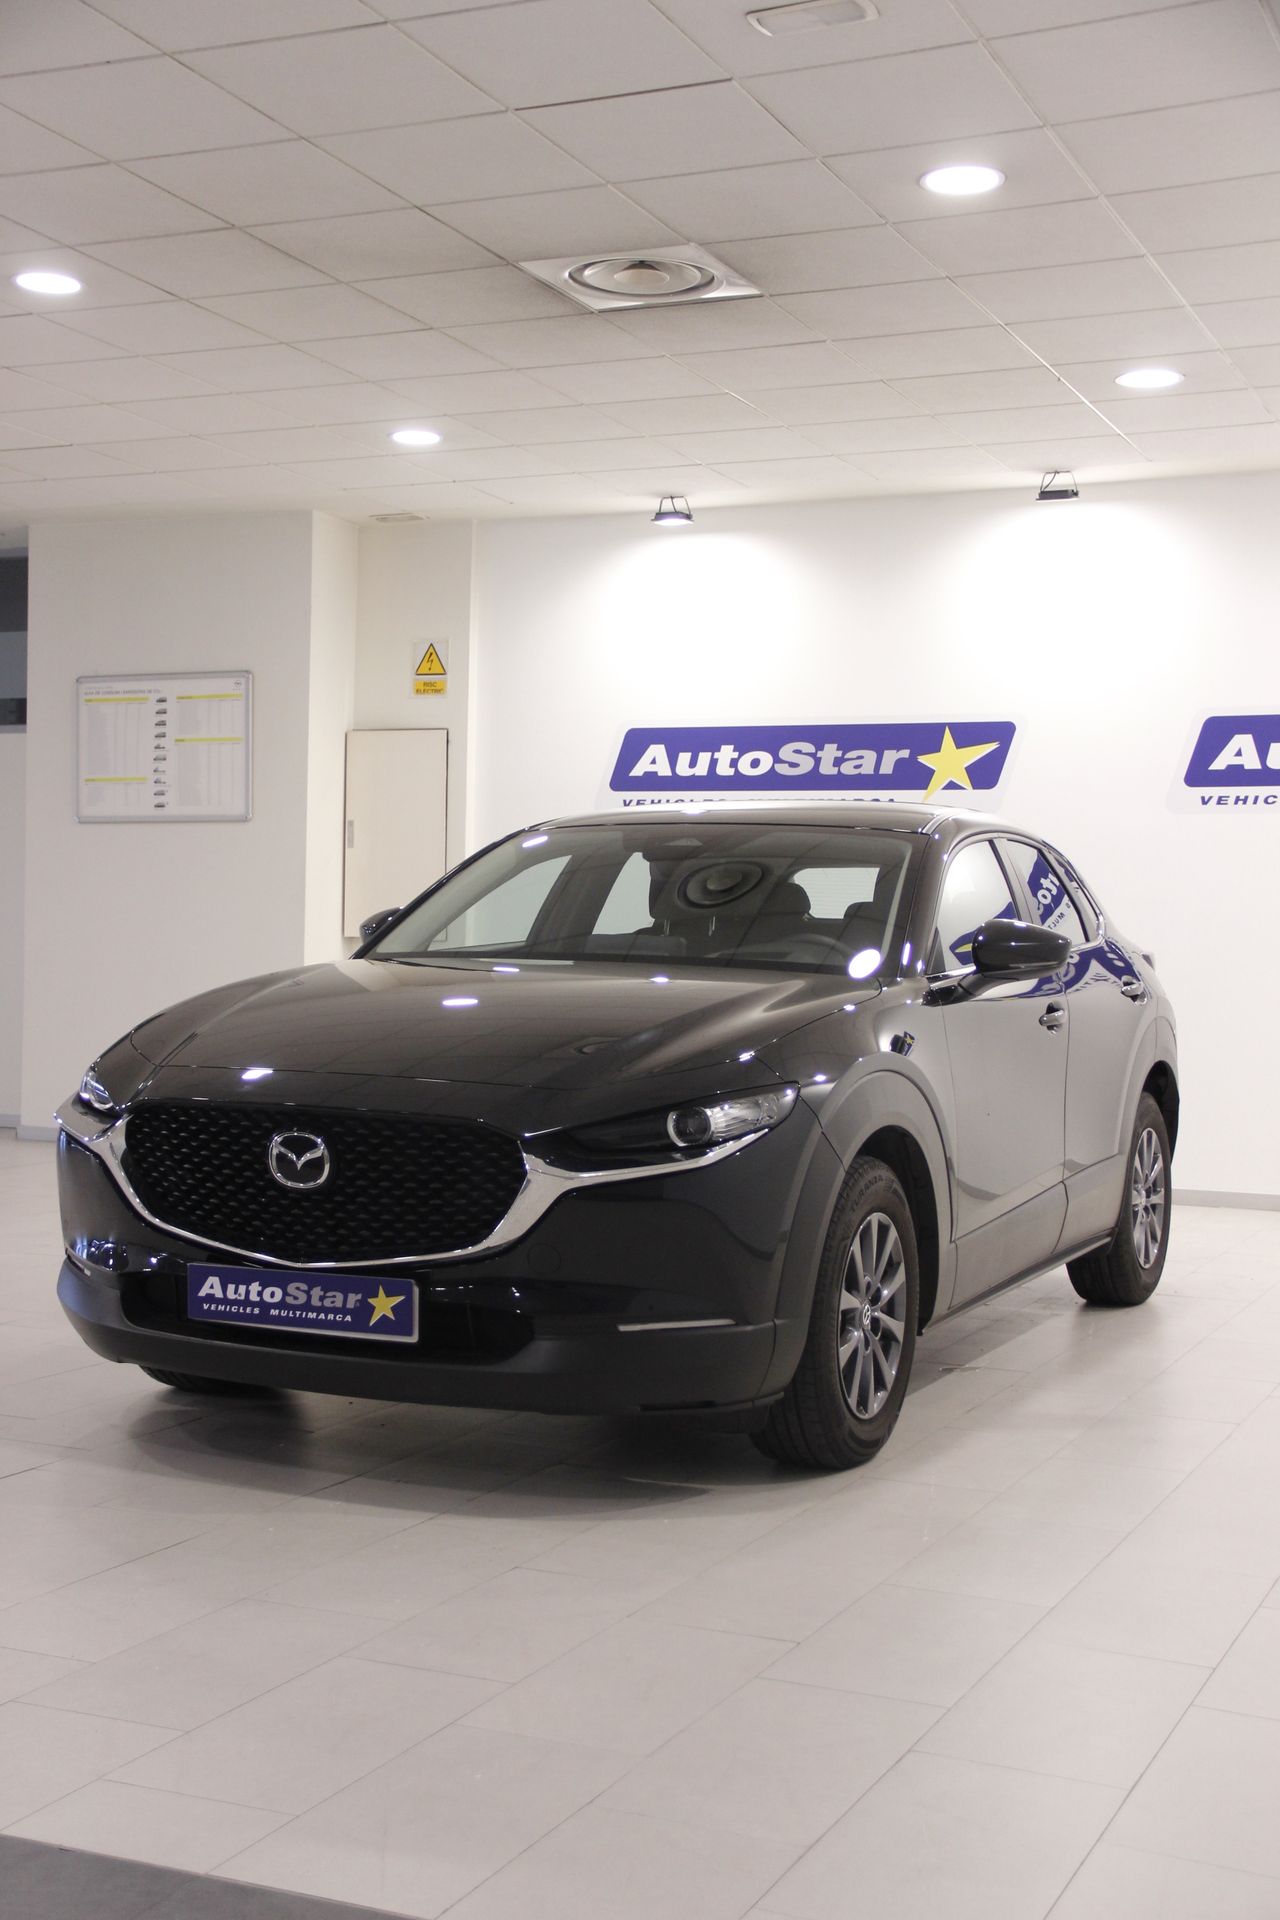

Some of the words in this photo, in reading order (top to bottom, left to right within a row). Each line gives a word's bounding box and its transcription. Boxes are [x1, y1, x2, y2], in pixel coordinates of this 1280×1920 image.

[628, 741, 911, 777] AutoStar
[1200, 794, 1279, 806] VEHIC
[197, 1275, 362, 1309] AutoStar
[202, 1302, 260, 1314] VEHICLES
[269, 1308, 352, 1322] MULTIMARCA
